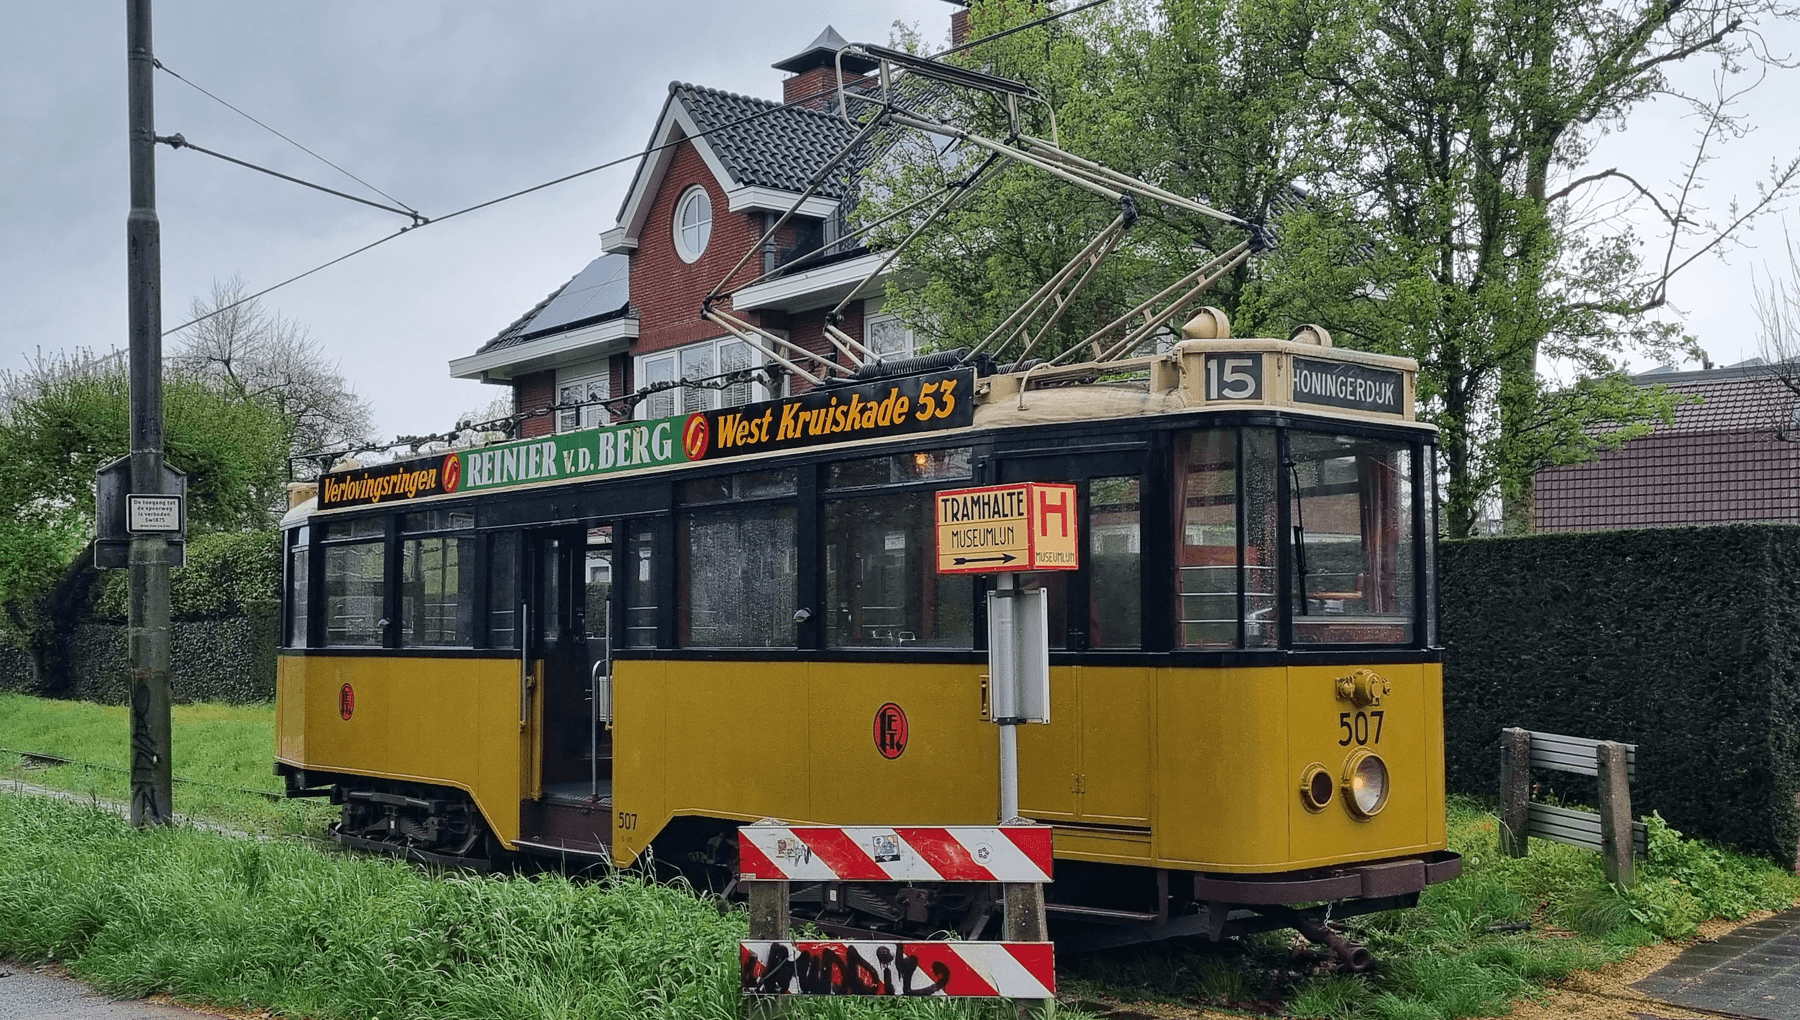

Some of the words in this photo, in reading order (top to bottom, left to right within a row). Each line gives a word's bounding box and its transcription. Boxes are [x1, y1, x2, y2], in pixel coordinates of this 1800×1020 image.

[1207, 358, 1256, 399] 15
[717, 412, 773, 449] West
[776, 387, 909, 441] Kruiskade
[915, 378, 957, 421] 53
[466, 440, 558, 488] REINIER
[597, 421, 673, 470] BERG
[324, 467, 437, 503] Verlovingsringen
[940, 491, 1025, 523] TRAMHALTE
[1039, 490, 1068, 538] H
[1338, 710, 1385, 747] 507
[618, 812, 638, 831] 507
